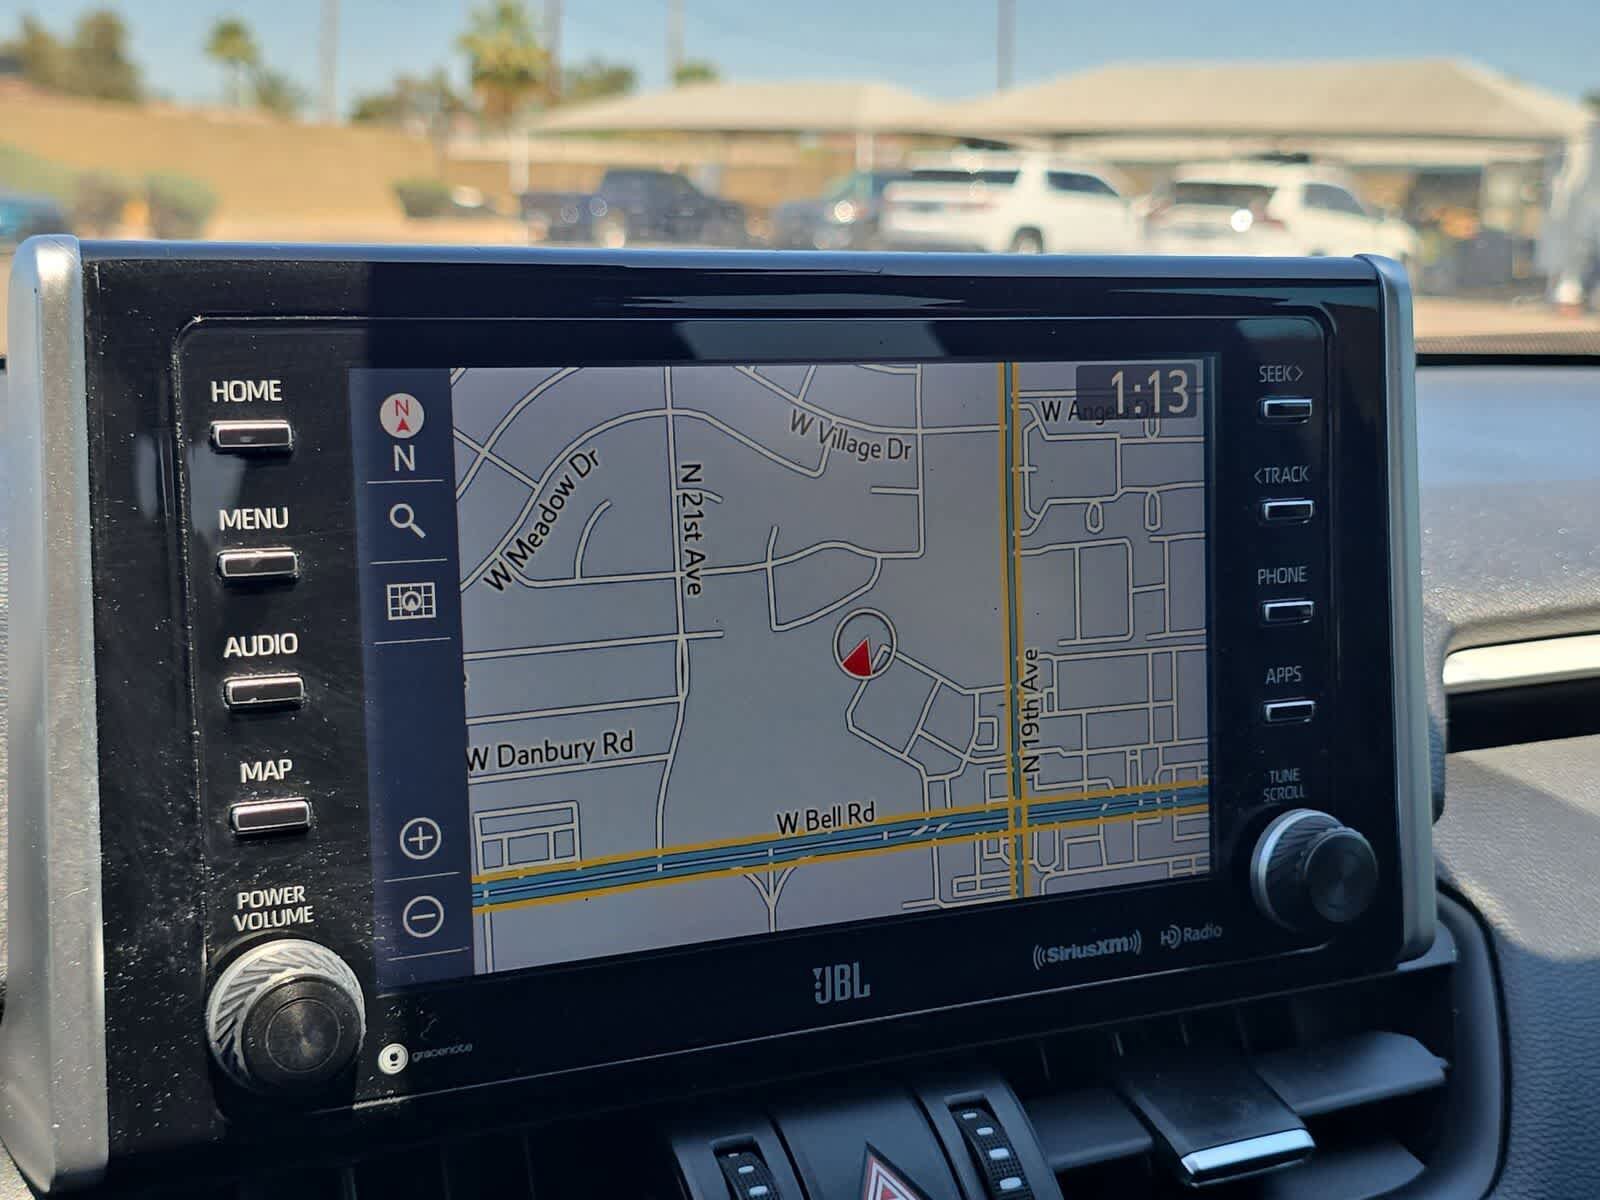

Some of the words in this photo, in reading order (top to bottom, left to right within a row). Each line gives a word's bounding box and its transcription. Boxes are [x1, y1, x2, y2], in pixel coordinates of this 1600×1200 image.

[1259, 365, 1292, 382] SEEK
[211, 380, 282, 402] HOME
[1111, 369, 1189, 415] 1:13
[395, 399, 409, 416] N
[1042, 400, 1061, 421] W
[791, 409, 814, 435] W
[819, 421, 881, 462] Village
[888, 437, 911, 460] Dr
[393, 445, 415, 471] N
[681, 463, 702, 483] N
[1264, 465, 1310, 483] TRACK
[219, 507, 289, 531] MENU
[484, 561, 513, 591] W
[507, 474, 576, 568] Meadow
[569, 448, 599, 478] Dr
[683, 492, 704, 541] 21st
[685, 549, 706, 595] Ave
[1257, 566, 1308, 584] PHONE
[223, 632, 298, 658] AUDIO
[1020, 649, 1038, 692] Ave
[1265, 665, 1302, 684] APPS
[1021, 699, 1039, 748] 19th
[466, 746, 489, 772] W
[497, 739, 596, 769] Danbury
[603, 730, 634, 755] Rd
[240, 759, 293, 784] MAP
[1022, 755, 1040, 774] N
[1269, 768, 1301, 784] TUNE
[1263, 784, 1305, 802] SCROLL
[776, 812, 799, 835] W
[805, 805, 842, 831] Bell
[848, 801, 875, 824] Rd
[236, 886, 306, 910] POWER
[232, 905, 315, 932] VOLUME
[1183, 923, 1223, 942] Radio
[812, 961, 871, 1004] JBL
